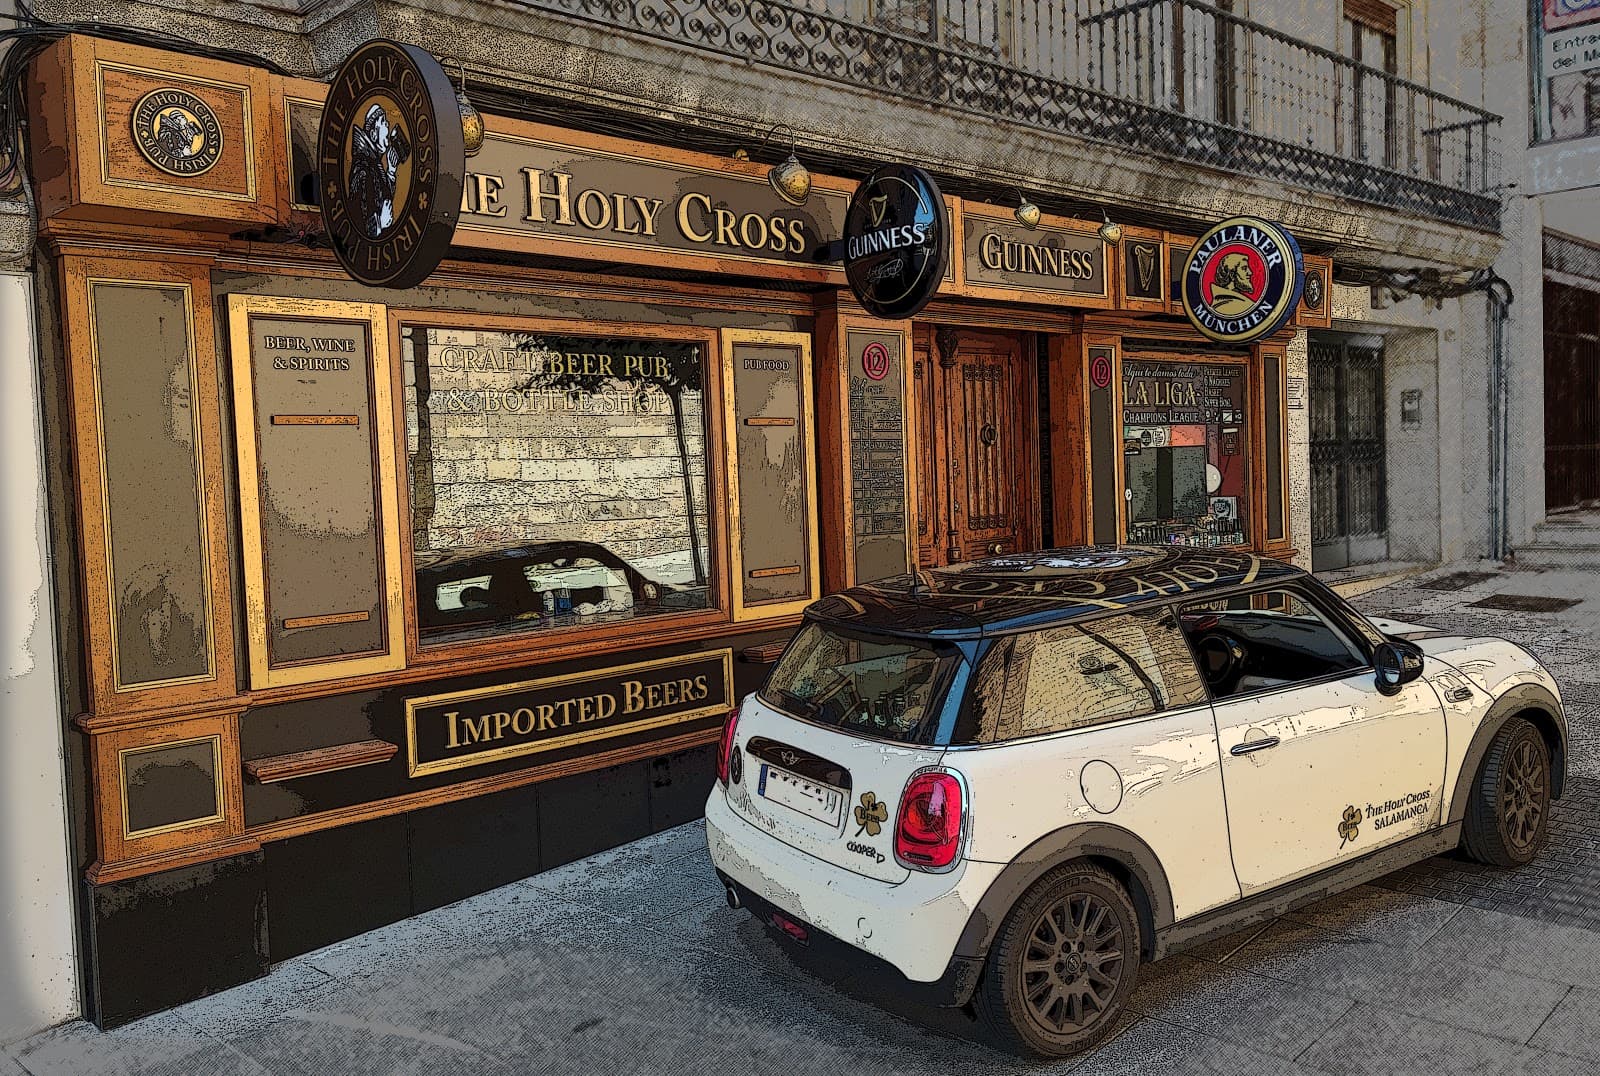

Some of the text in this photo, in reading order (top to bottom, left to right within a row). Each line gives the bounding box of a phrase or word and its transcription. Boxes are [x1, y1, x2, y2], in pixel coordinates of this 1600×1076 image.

[1552, 54, 1577, 69] del
[137, 92, 219, 147] THE HOLY CROSS
[322, 55, 433, 184] THE HOLY CROSS
[143, 138, 213, 171] IRISH PUB
[522, 167, 663, 236] HOLY
[677, 192, 806, 254] CROSS
[367, 214, 422, 272] IRISH
[848, 223, 926, 260] GUINNESS
[1189, 225, 1282, 275] PAULANER
[981, 233, 1093, 280] GUINNESS
[264, 335, 356, 352] BEER, WINE
[273, 357, 350, 371] & SPIRITS
[440, 346, 669, 378] CRAFT BEER PUB
[744, 359, 790, 370] PUB FOOD
[866, 351, 884, 372] 12
[446, 386, 668, 413] & BOTTLE SHOP
[1123, 381, 1197, 405] LA LIGA
[1123, 409, 1199, 423] CHAMPIONS LEAGUE
[444, 675, 709, 749] IMPORTED BEERS
[1365, 790, 1430, 819] THE HOLY CROSS
[1374, 803, 1428, 831] SALAMANCA
[846, 841, 886, 865] COOPER D
